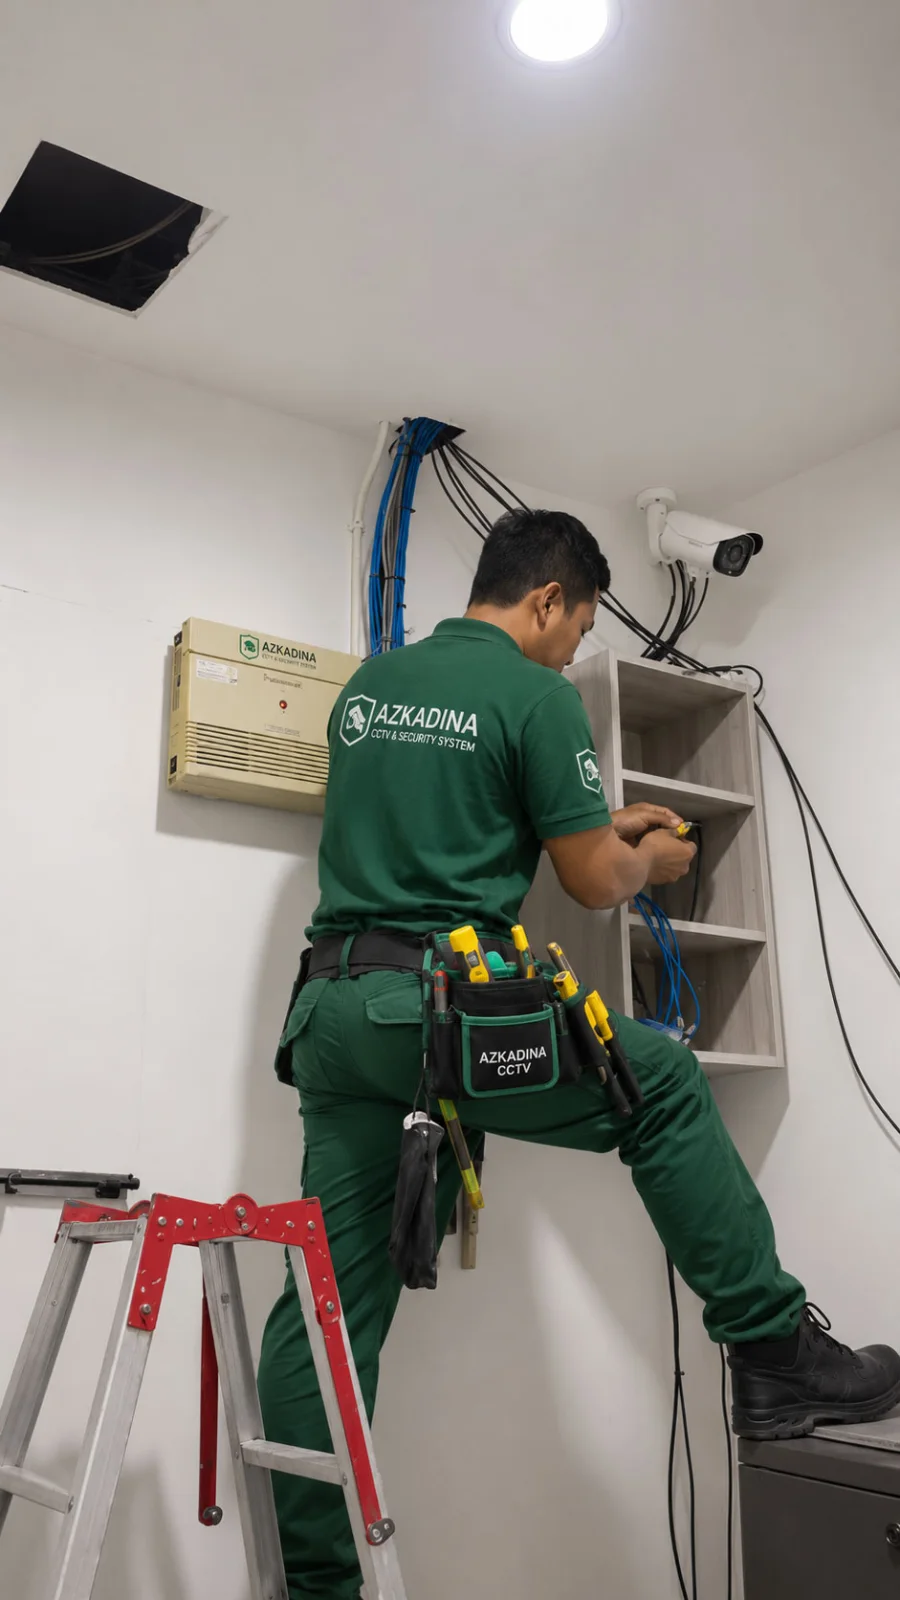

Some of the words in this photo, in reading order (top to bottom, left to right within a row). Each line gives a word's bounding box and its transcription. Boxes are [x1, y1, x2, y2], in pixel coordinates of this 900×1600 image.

[262, 641, 317, 663] AZKADINA
[374, 703, 478, 737] AZKADINA
[371, 728, 391, 739] CCTV
[391, 730, 397, 741] &
[398, 731, 437, 745] SECURITY
[437, 735, 476, 752] SYSTEM
[479, 1046, 547, 1064] AZKADINA
[497, 1062, 532, 1077] CCTV
